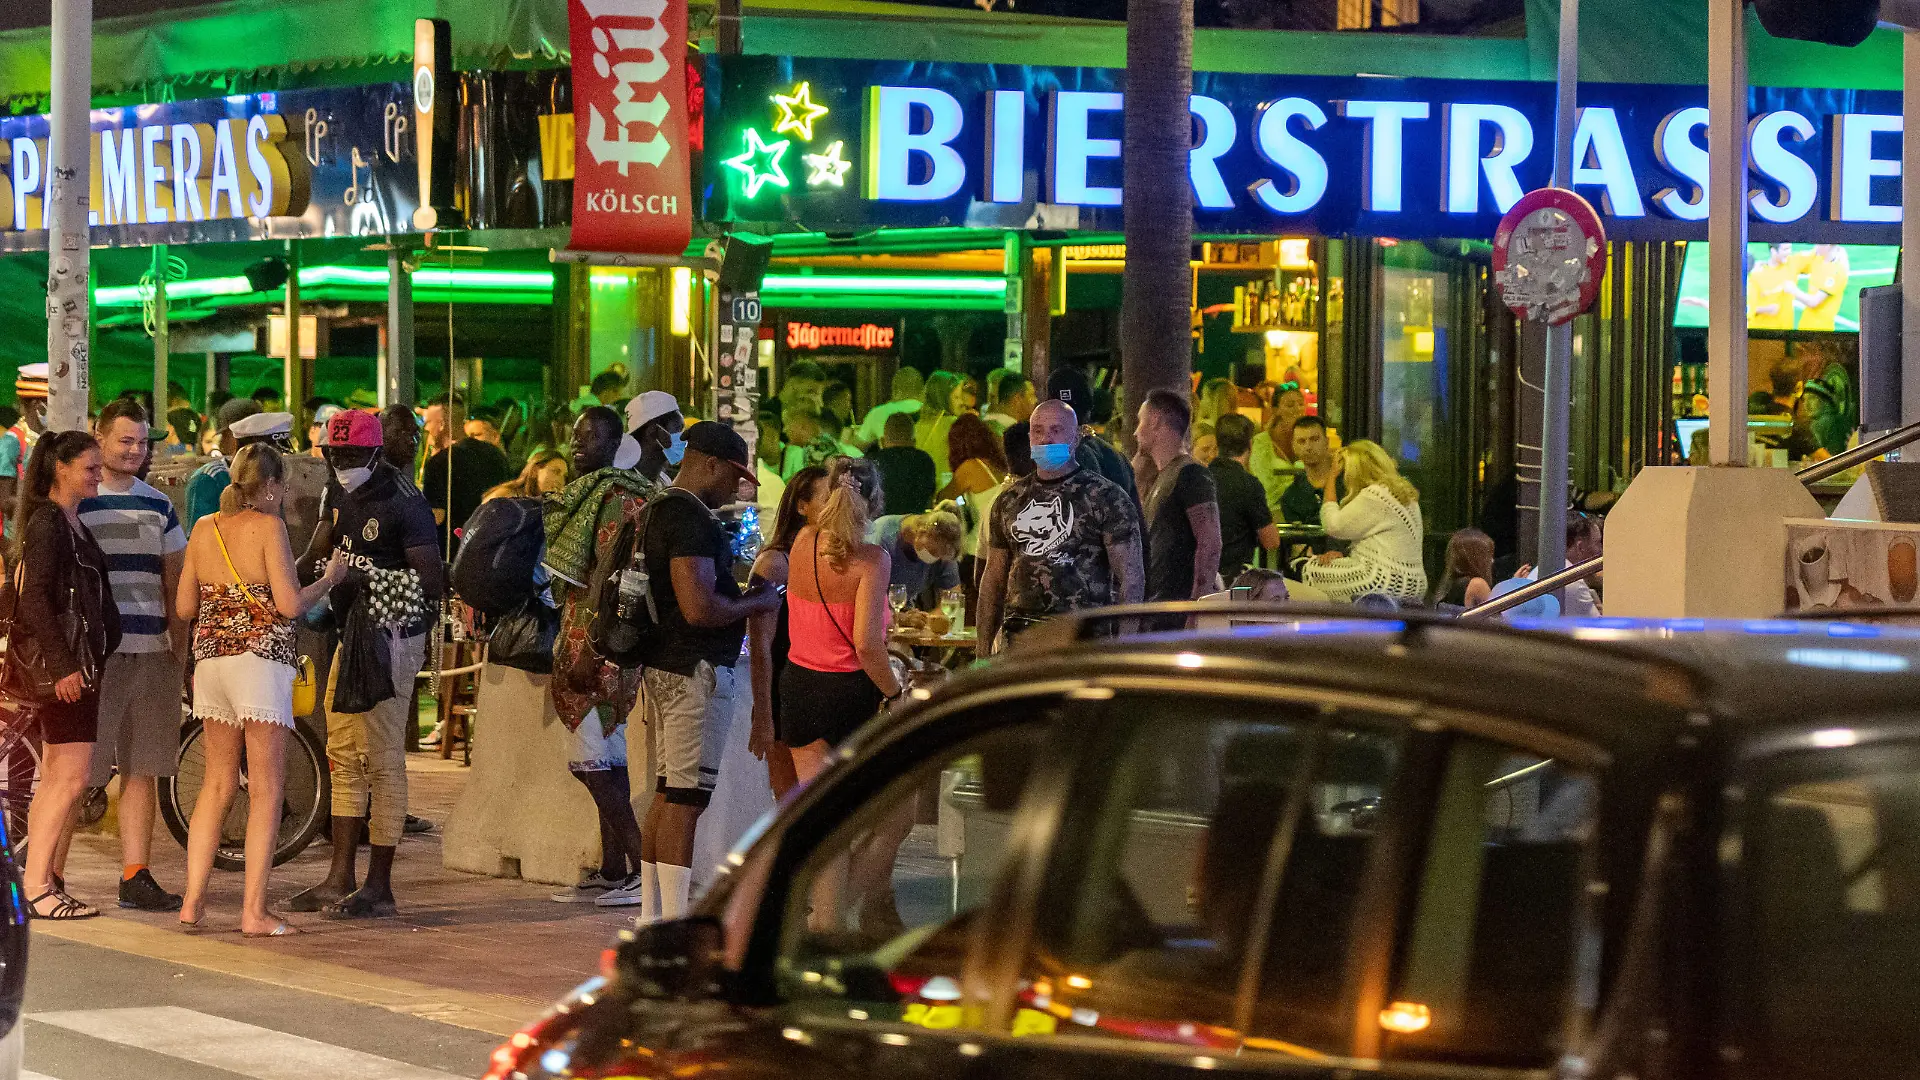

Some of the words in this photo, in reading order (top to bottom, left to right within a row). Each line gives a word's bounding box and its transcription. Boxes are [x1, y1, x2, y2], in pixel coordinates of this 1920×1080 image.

[868, 85, 1904, 224] BIERSTRASSE
[13, 114, 274, 231] PMERAS
[586, 188, 678, 216] KÖLSCH
[739, 301, 759, 320] 10
[786, 322, 894, 351] Jägermeister
[333, 425, 350, 442] 23
